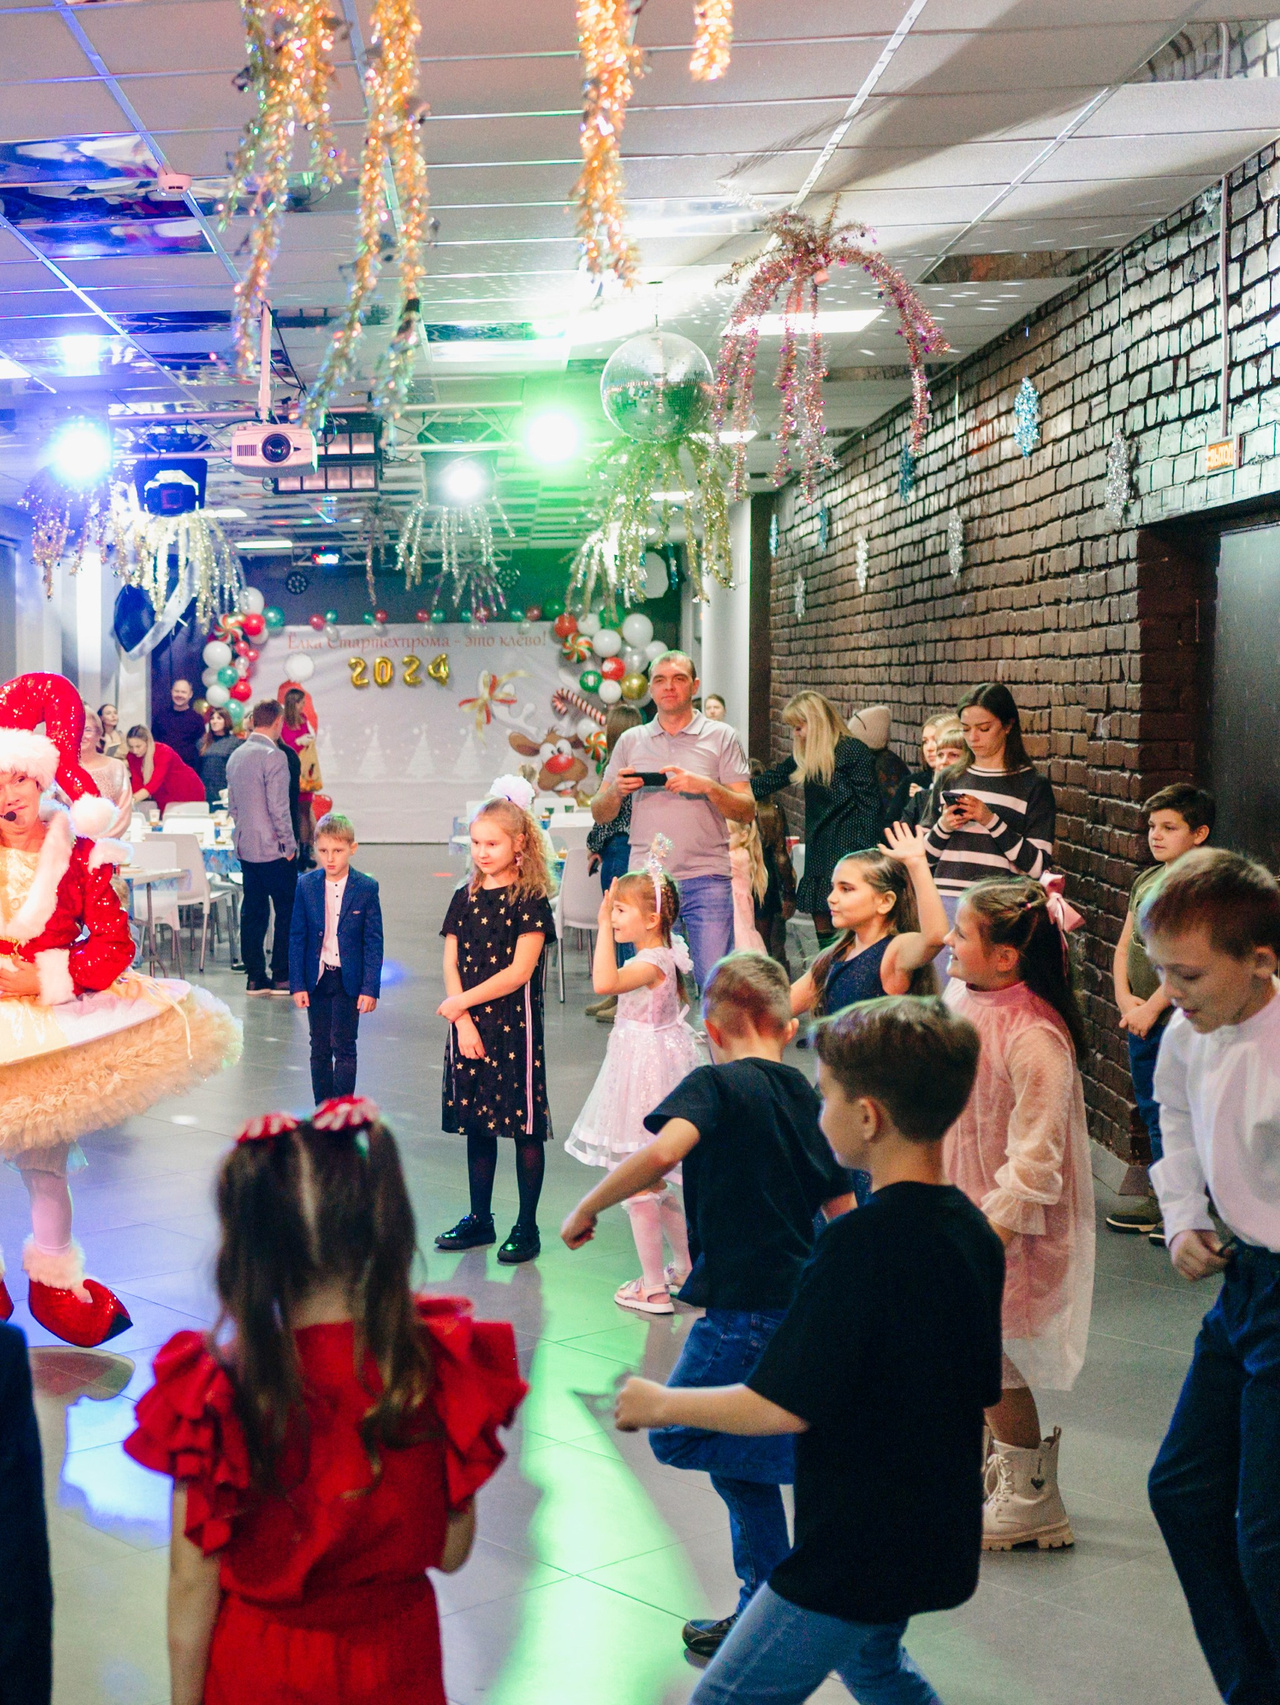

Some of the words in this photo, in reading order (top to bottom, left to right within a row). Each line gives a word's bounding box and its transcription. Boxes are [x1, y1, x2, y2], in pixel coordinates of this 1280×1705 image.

[288, 632, 323, 650] Ёлка
[465, 635, 495, 647] это
[348, 653, 449, 687] 2024
